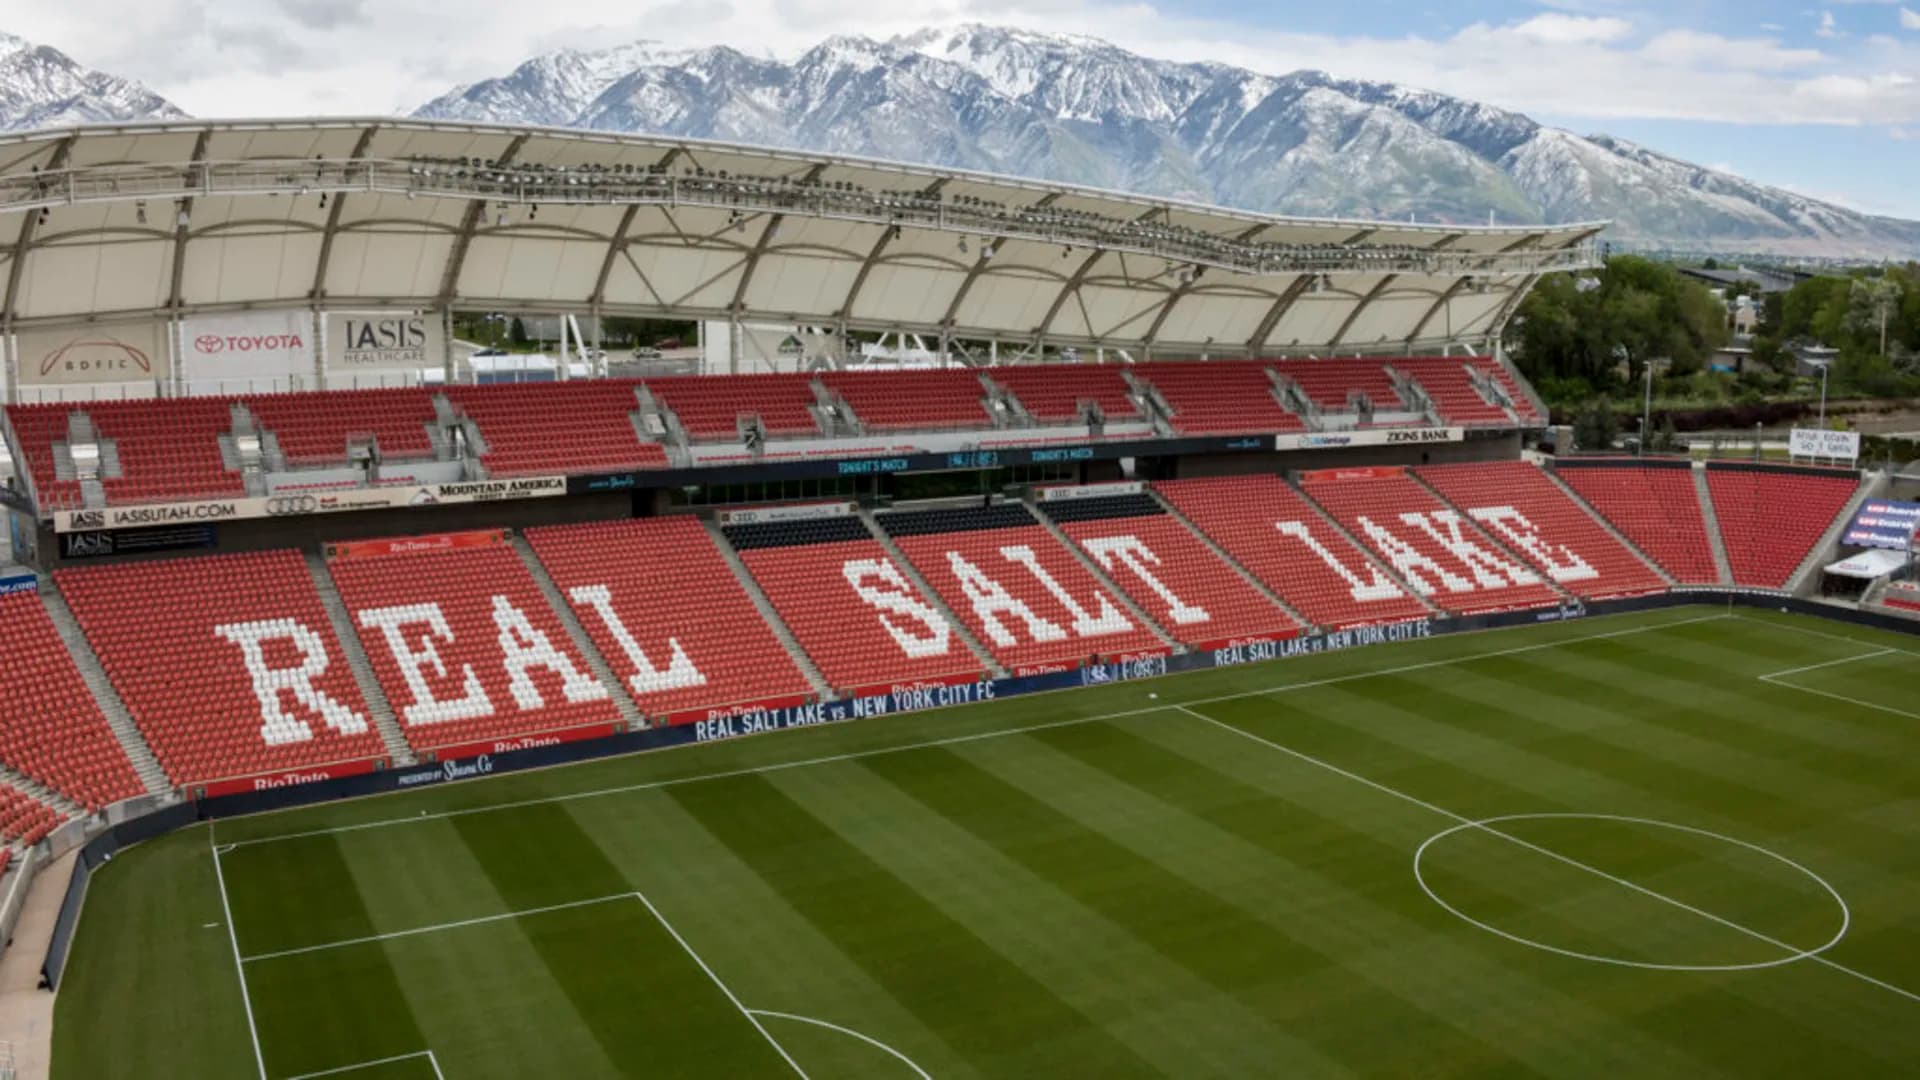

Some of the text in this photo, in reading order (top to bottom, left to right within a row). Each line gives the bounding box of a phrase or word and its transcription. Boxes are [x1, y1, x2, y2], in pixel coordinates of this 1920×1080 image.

[228, 335, 303, 352] TOYOTA
[345, 318, 426, 349] IASIS
[344, 351, 425, 363] HEALTHCARE
[1386, 429, 1449, 442] ZIONS BANK
[439, 478, 564, 498] MOUNTAIN AMERICA
[70, 503, 236, 524] IASIS IASISUTAH.COM
[1214, 645, 1246, 667] REAL
[1248, 641, 1277, 661] SALT
[1280, 636, 1310, 657] LAKE
[1327, 631, 1352, 649] NEW
[1355, 624, 1386, 644] YORK
[1388, 622, 1413, 641] CITY
[1416, 620, 1432, 638] FC
[695, 718, 738, 741] REAL
[742, 709, 780, 734] SALT
[785, 703, 826, 727] LAKE
[853, 694, 888, 718] NEW
[892, 687, 934, 712] YORK
[938, 683, 971, 706] CITY
[976, 681, 995, 700] FC
